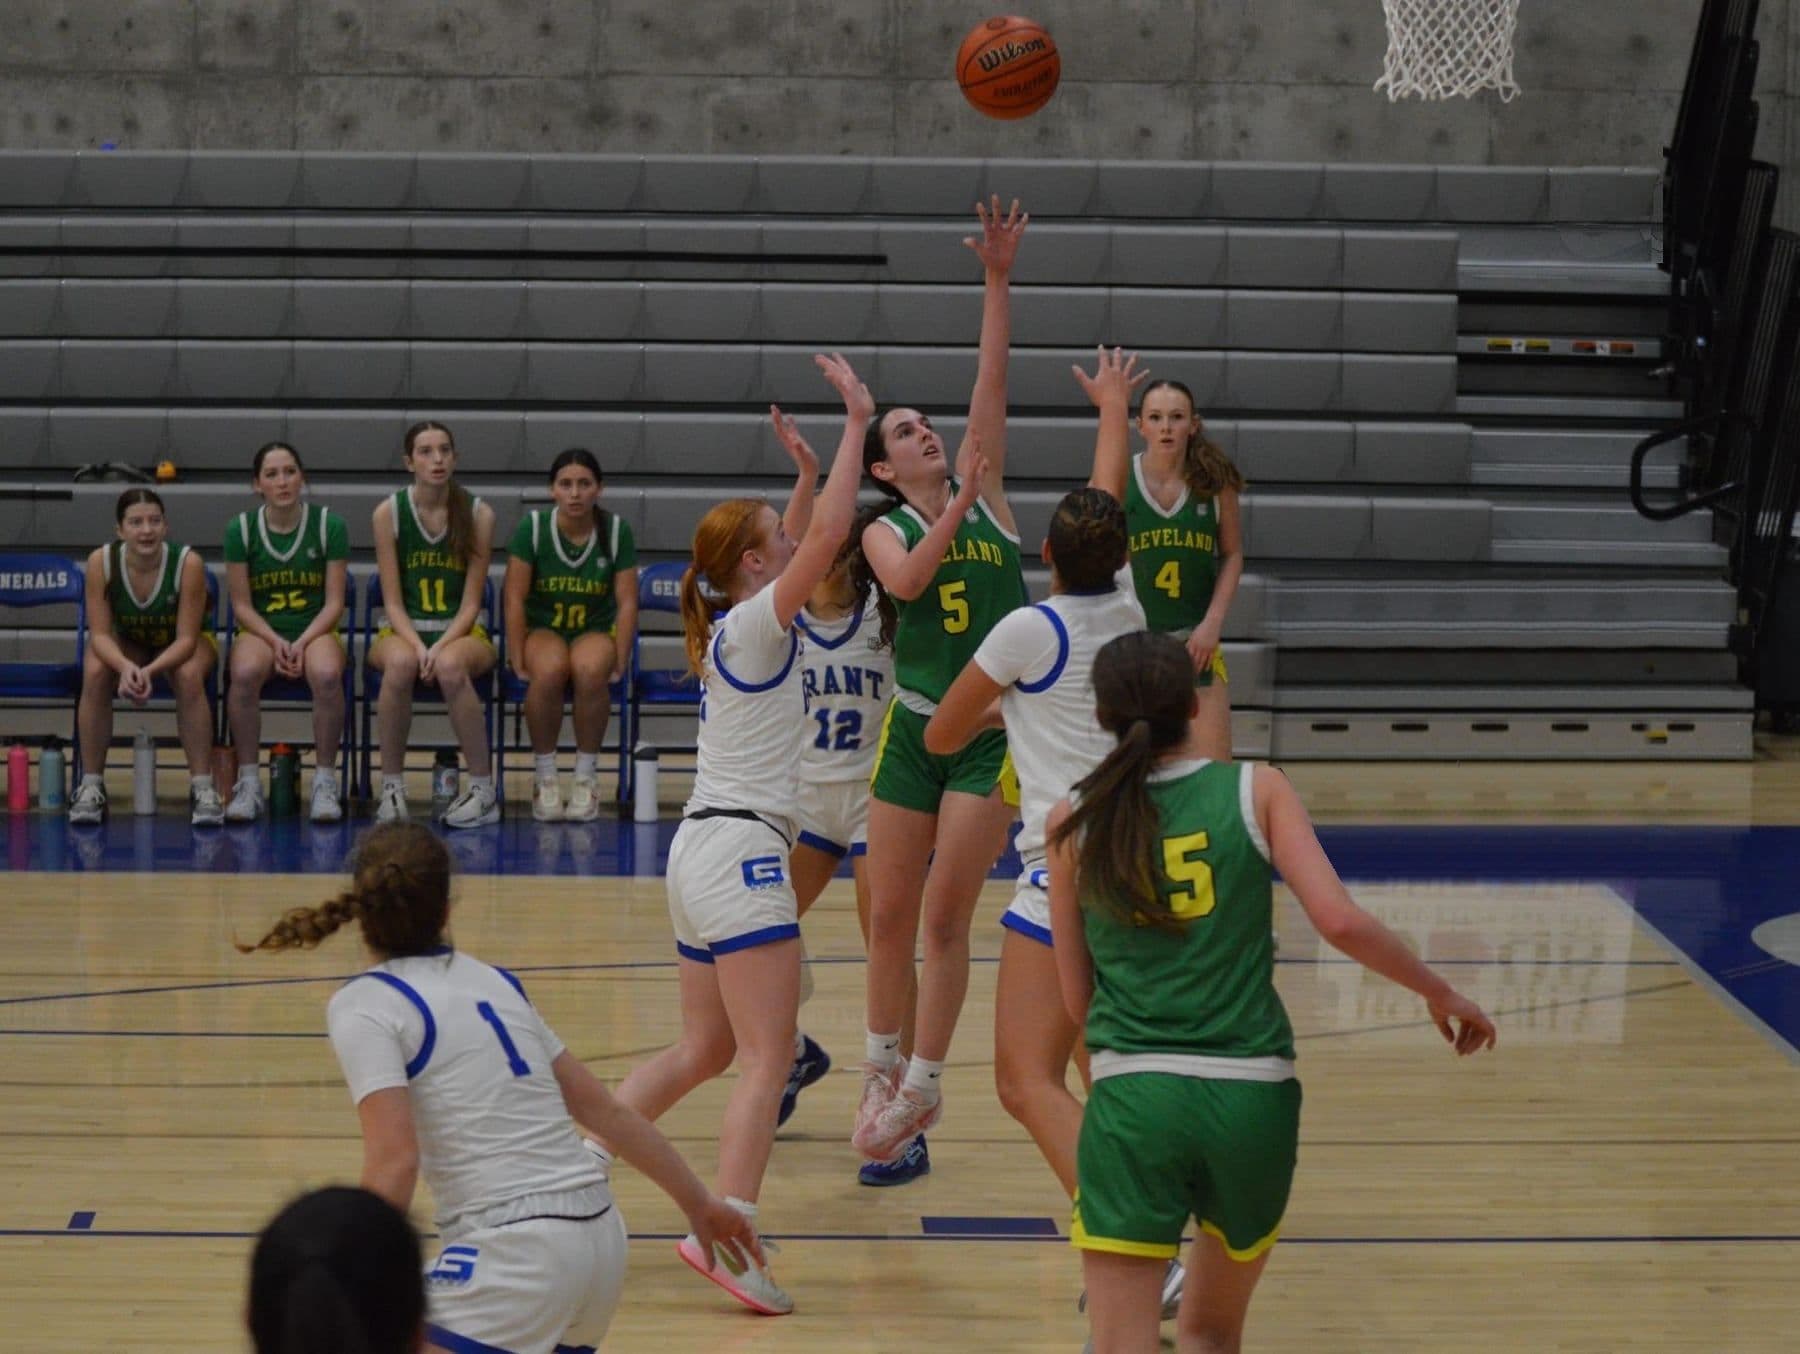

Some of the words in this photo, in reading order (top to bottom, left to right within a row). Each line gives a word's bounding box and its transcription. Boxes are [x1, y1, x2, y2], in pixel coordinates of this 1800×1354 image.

[978, 38, 1046, 72] Wilson
[0, 571, 67, 589] NERALS
[419, 578, 448, 612] 11
[1155, 560, 1181, 598] 4
[938, 580, 969, 634] 5
[802, 665, 884, 700] RANT
[814, 708, 863, 750] 12
[742, 855, 784, 887] G
[1135, 831, 1217, 922] 5
[476, 1001, 531, 1077] 1
